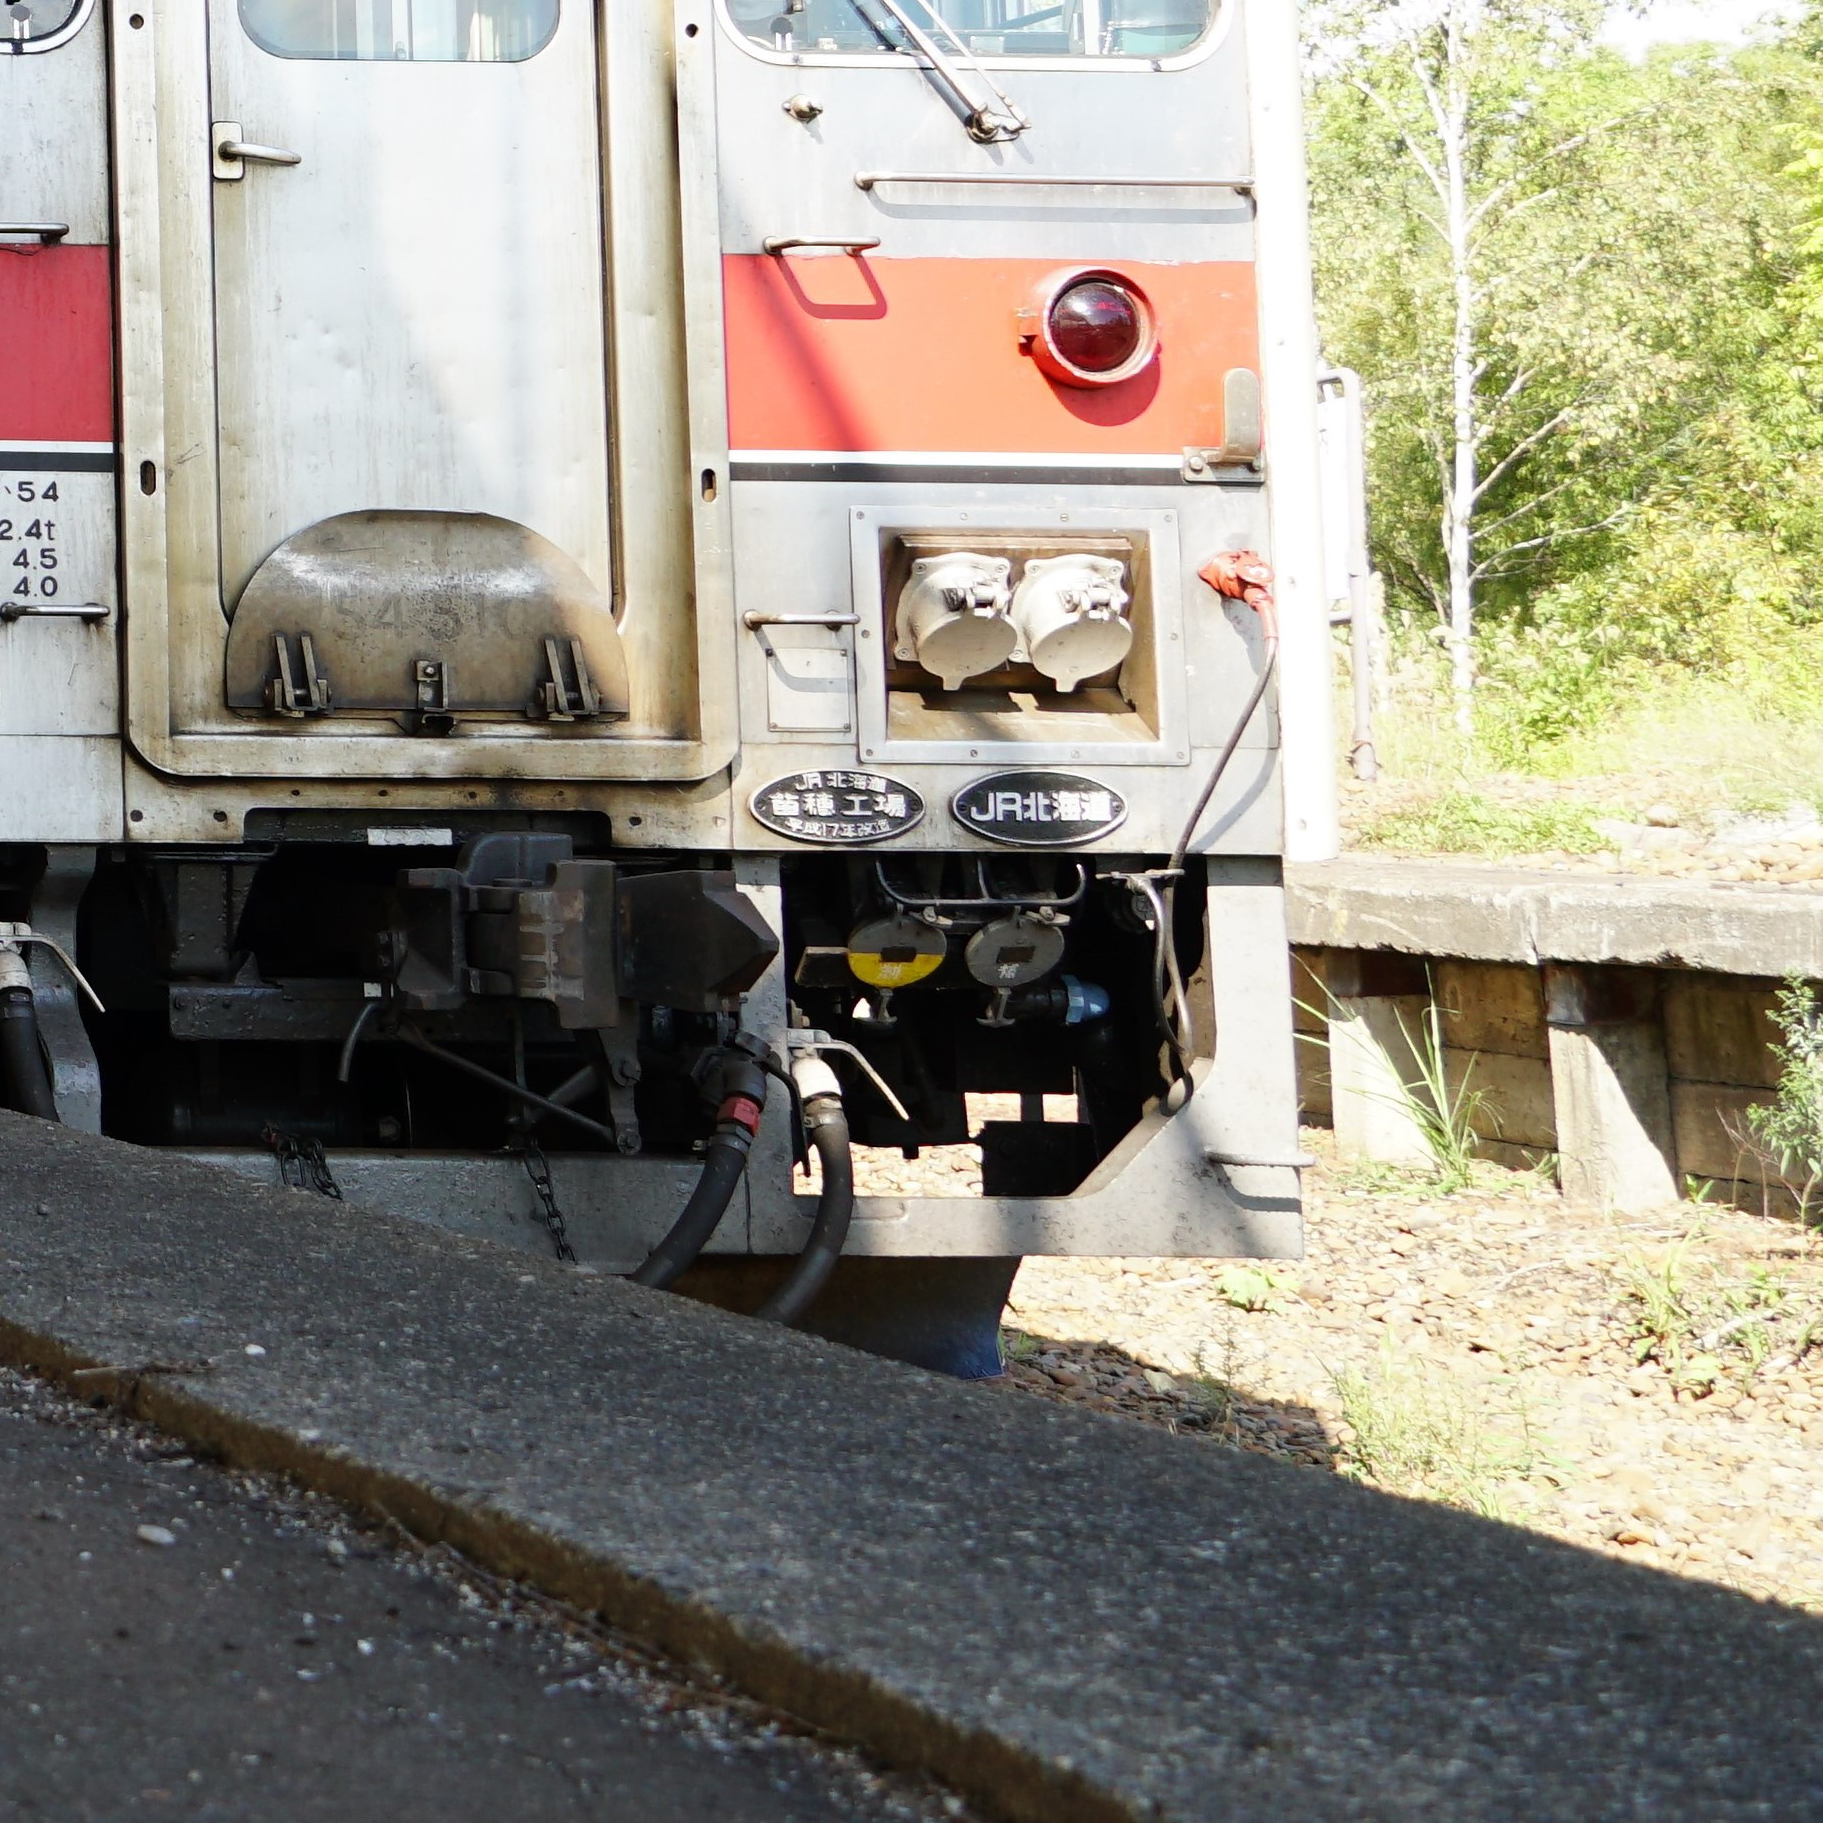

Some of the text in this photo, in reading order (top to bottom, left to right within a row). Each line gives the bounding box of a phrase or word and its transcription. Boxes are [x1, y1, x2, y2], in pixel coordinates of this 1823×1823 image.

[13, 547, 58, 571] 4.5
[13, 575, 58, 598] 4.0
[769, 792, 907, 819] 苗穂工場
[970, 789, 1112, 823] JR北海道
